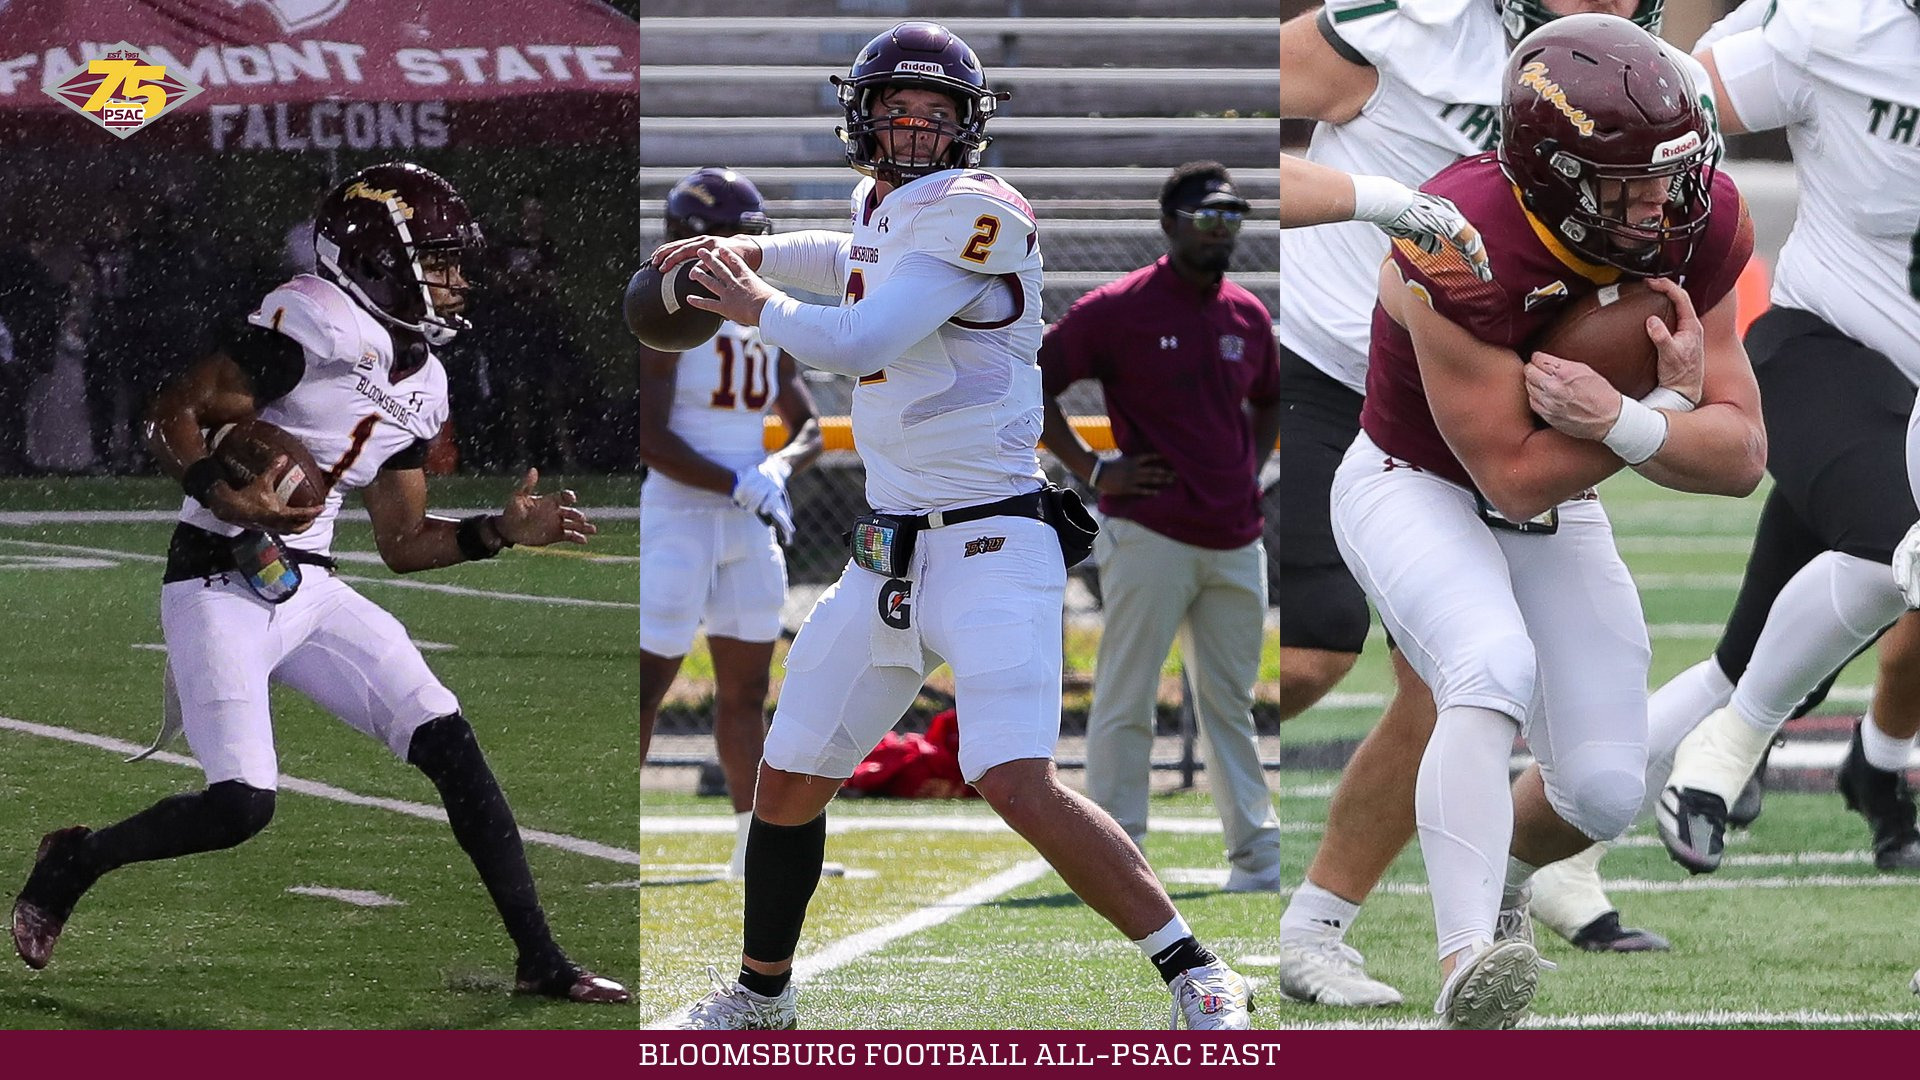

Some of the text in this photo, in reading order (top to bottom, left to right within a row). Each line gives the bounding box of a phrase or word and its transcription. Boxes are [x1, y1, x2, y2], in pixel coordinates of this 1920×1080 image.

[396, 45, 633, 85] STATE
[900, 62, 940, 73] Riddell
[210, 102, 449, 151] FALCONS
[1867, 97, 1920, 146] TH
[1661, 137, 1698, 159] Riddell
[960, 213, 1002, 265] 2
[711, 334, 770, 412] 10
[355, 376, 411, 426] BLOOMSBURG
[878, 578, 913, 630] G
